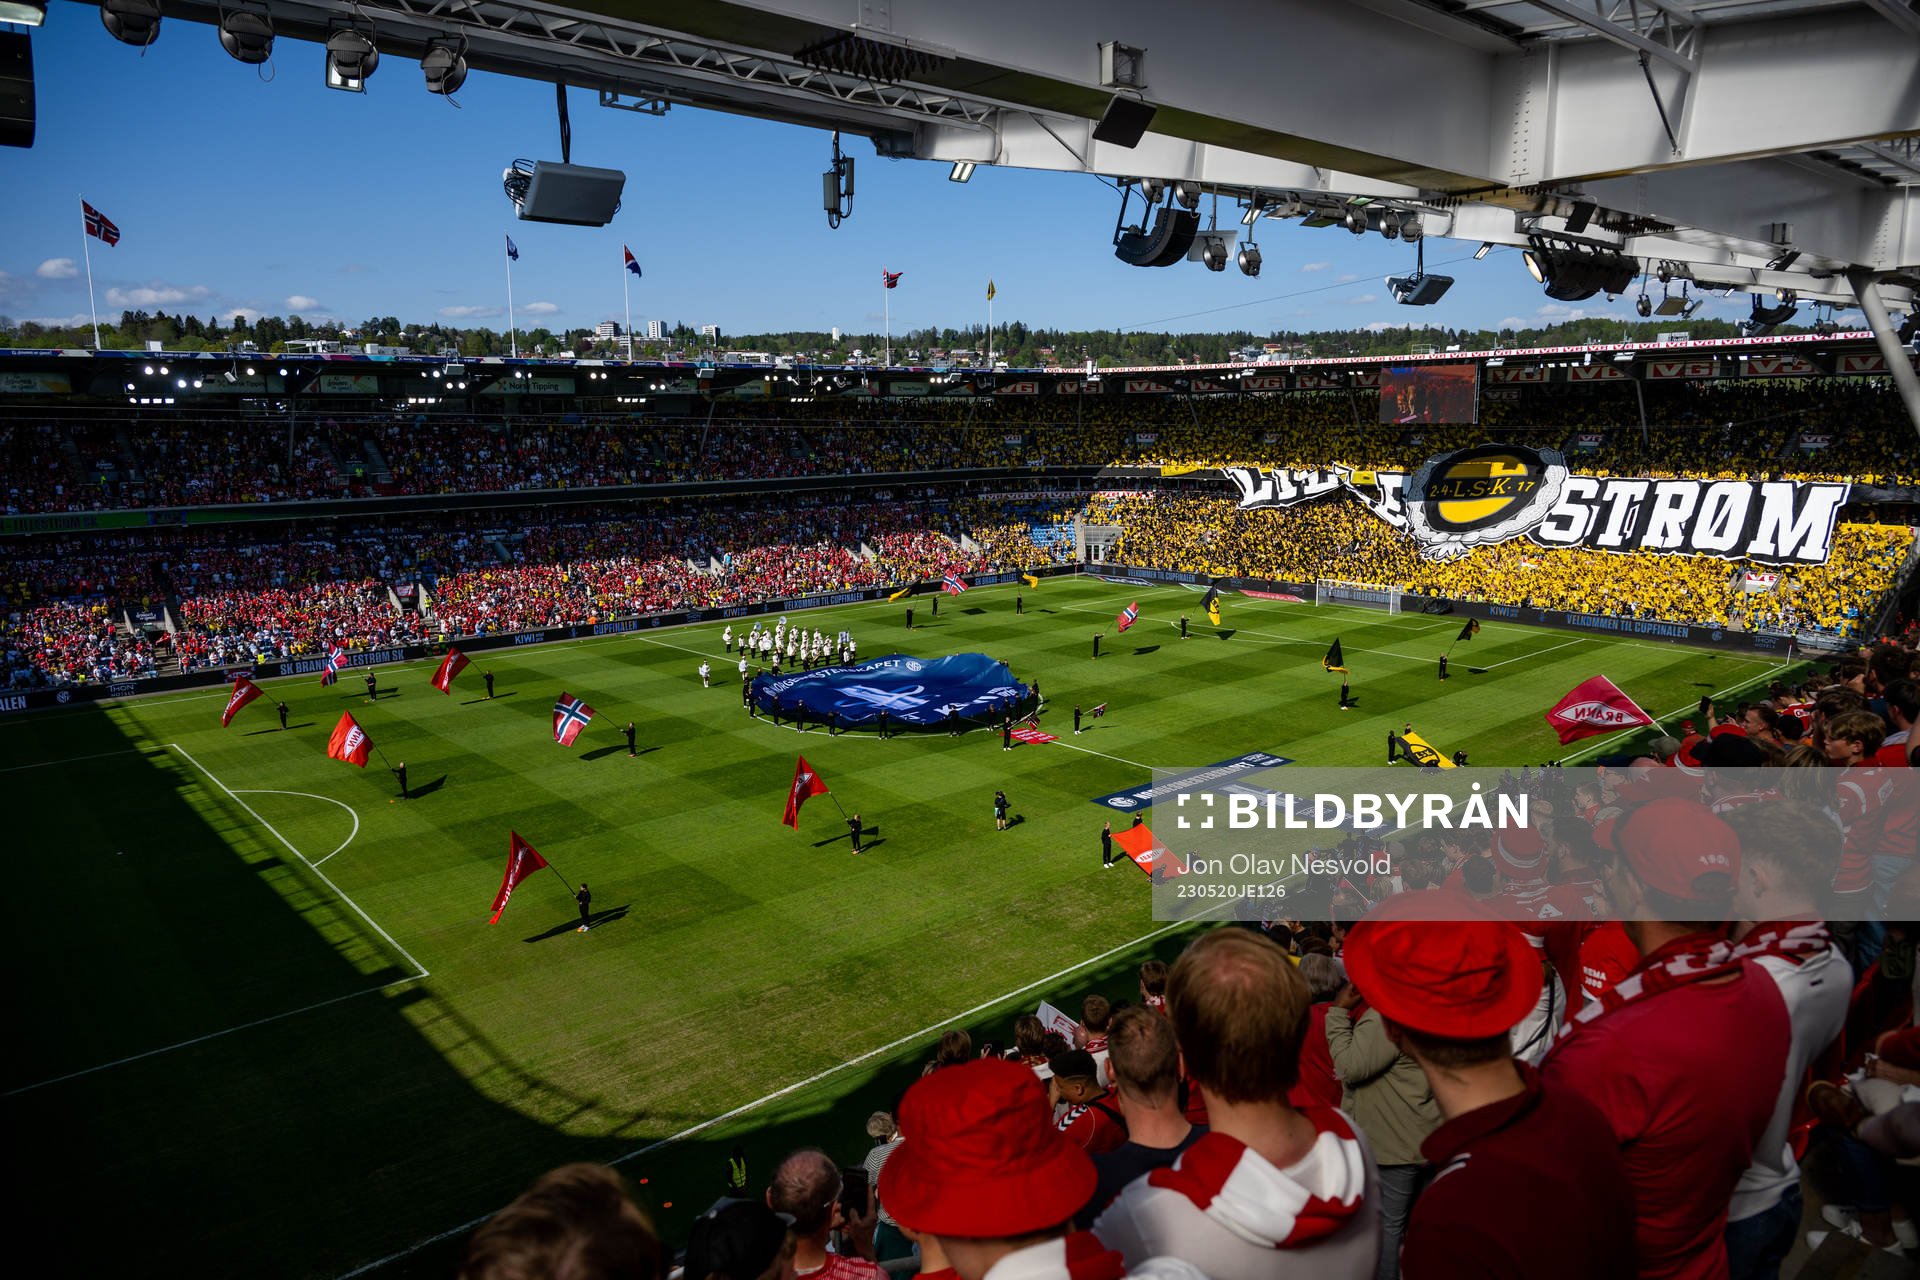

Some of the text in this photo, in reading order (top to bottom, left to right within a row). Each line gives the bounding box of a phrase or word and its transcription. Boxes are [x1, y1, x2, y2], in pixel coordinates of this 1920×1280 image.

[1494, 369, 1541, 381] VG
[1576, 367, 1625, 379] VG
[1656, 363, 1710, 376] VG
[1001, 382, 1033, 393] VG
[1246, 378, 1281, 388] VG
[1539, 480, 1845, 562] STRØM
[784, 592, 864, 611] VELKOMMEN TIL CUPFINALEN
[1490, 606, 1510, 617] KIWI
[1567, 614, 1689, 638] VELKOMMEN TIL CUPFINALEN
[514, 633, 535, 645] KIWI
[1754, 636, 1776, 645] THON
[280, 662, 294, 675] SK
[296, 658, 328, 673] BRANN
[391, 649, 405, 661] SK
[0, 696, 27, 712] ALEN
